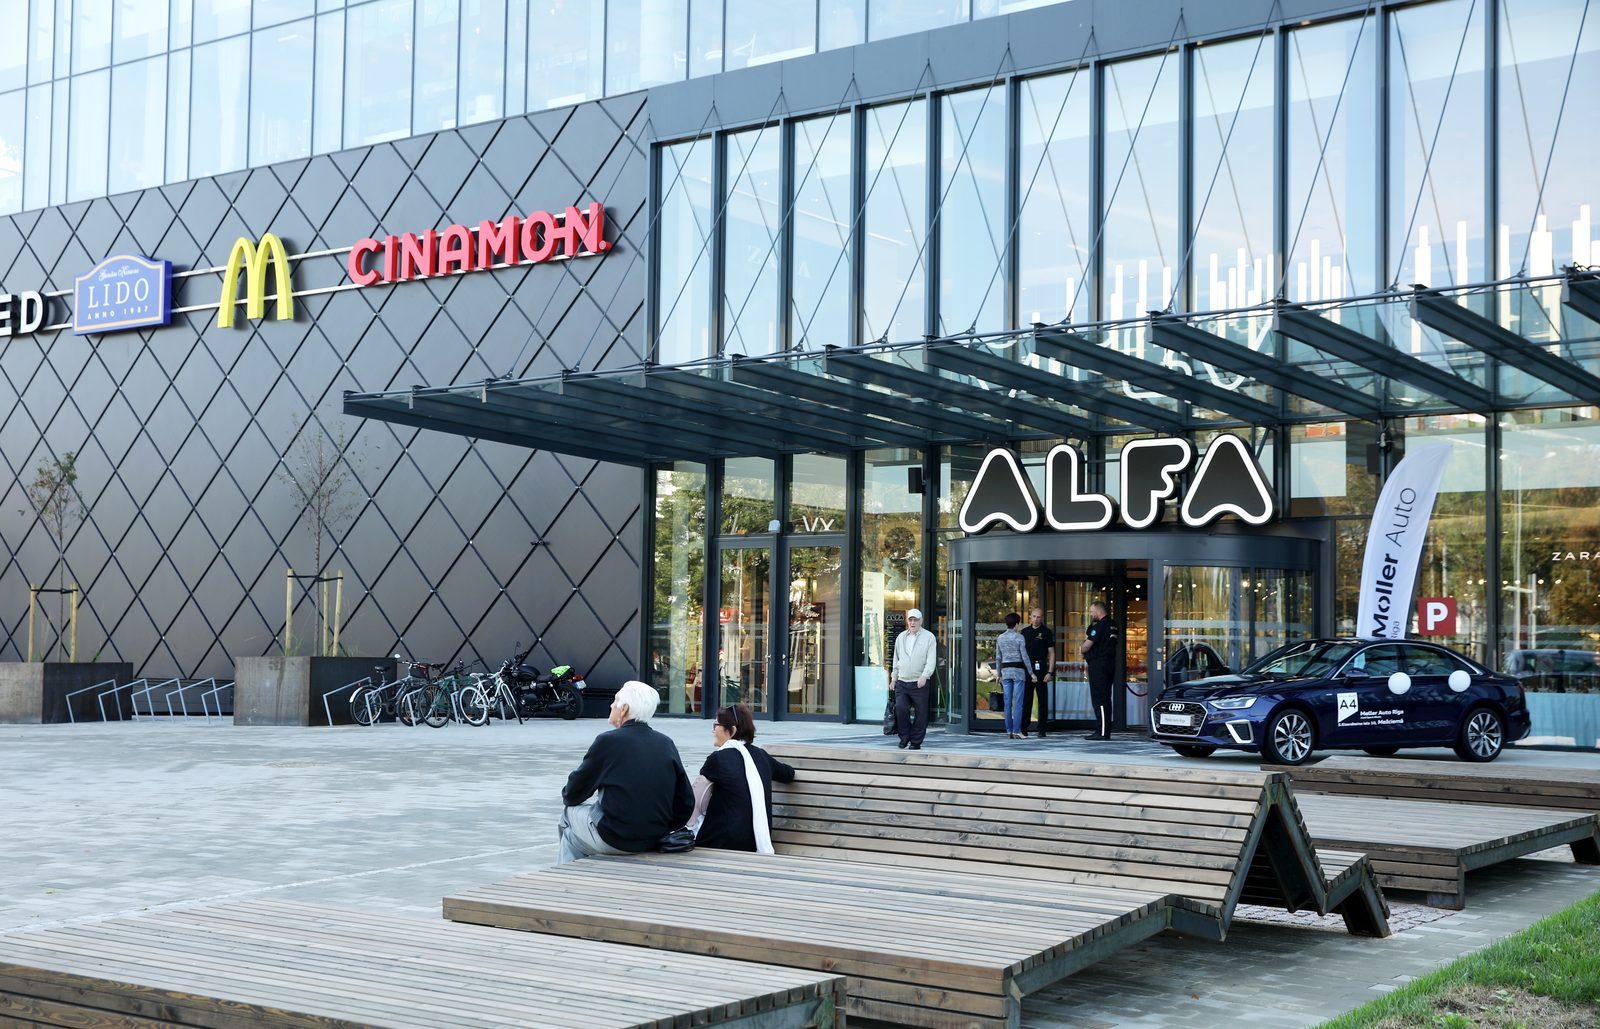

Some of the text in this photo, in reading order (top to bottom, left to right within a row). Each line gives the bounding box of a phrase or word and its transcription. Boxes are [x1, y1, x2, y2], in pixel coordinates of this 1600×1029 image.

[88, 277, 150, 309] LIDO
[87, 310, 116, 321] ANNO
[958, 433, 1275, 533] ALFA
[1385, 487, 1416, 547] Auto
[1427, 602, 1449, 631] P
[1339, 699, 1357, 710] A4
